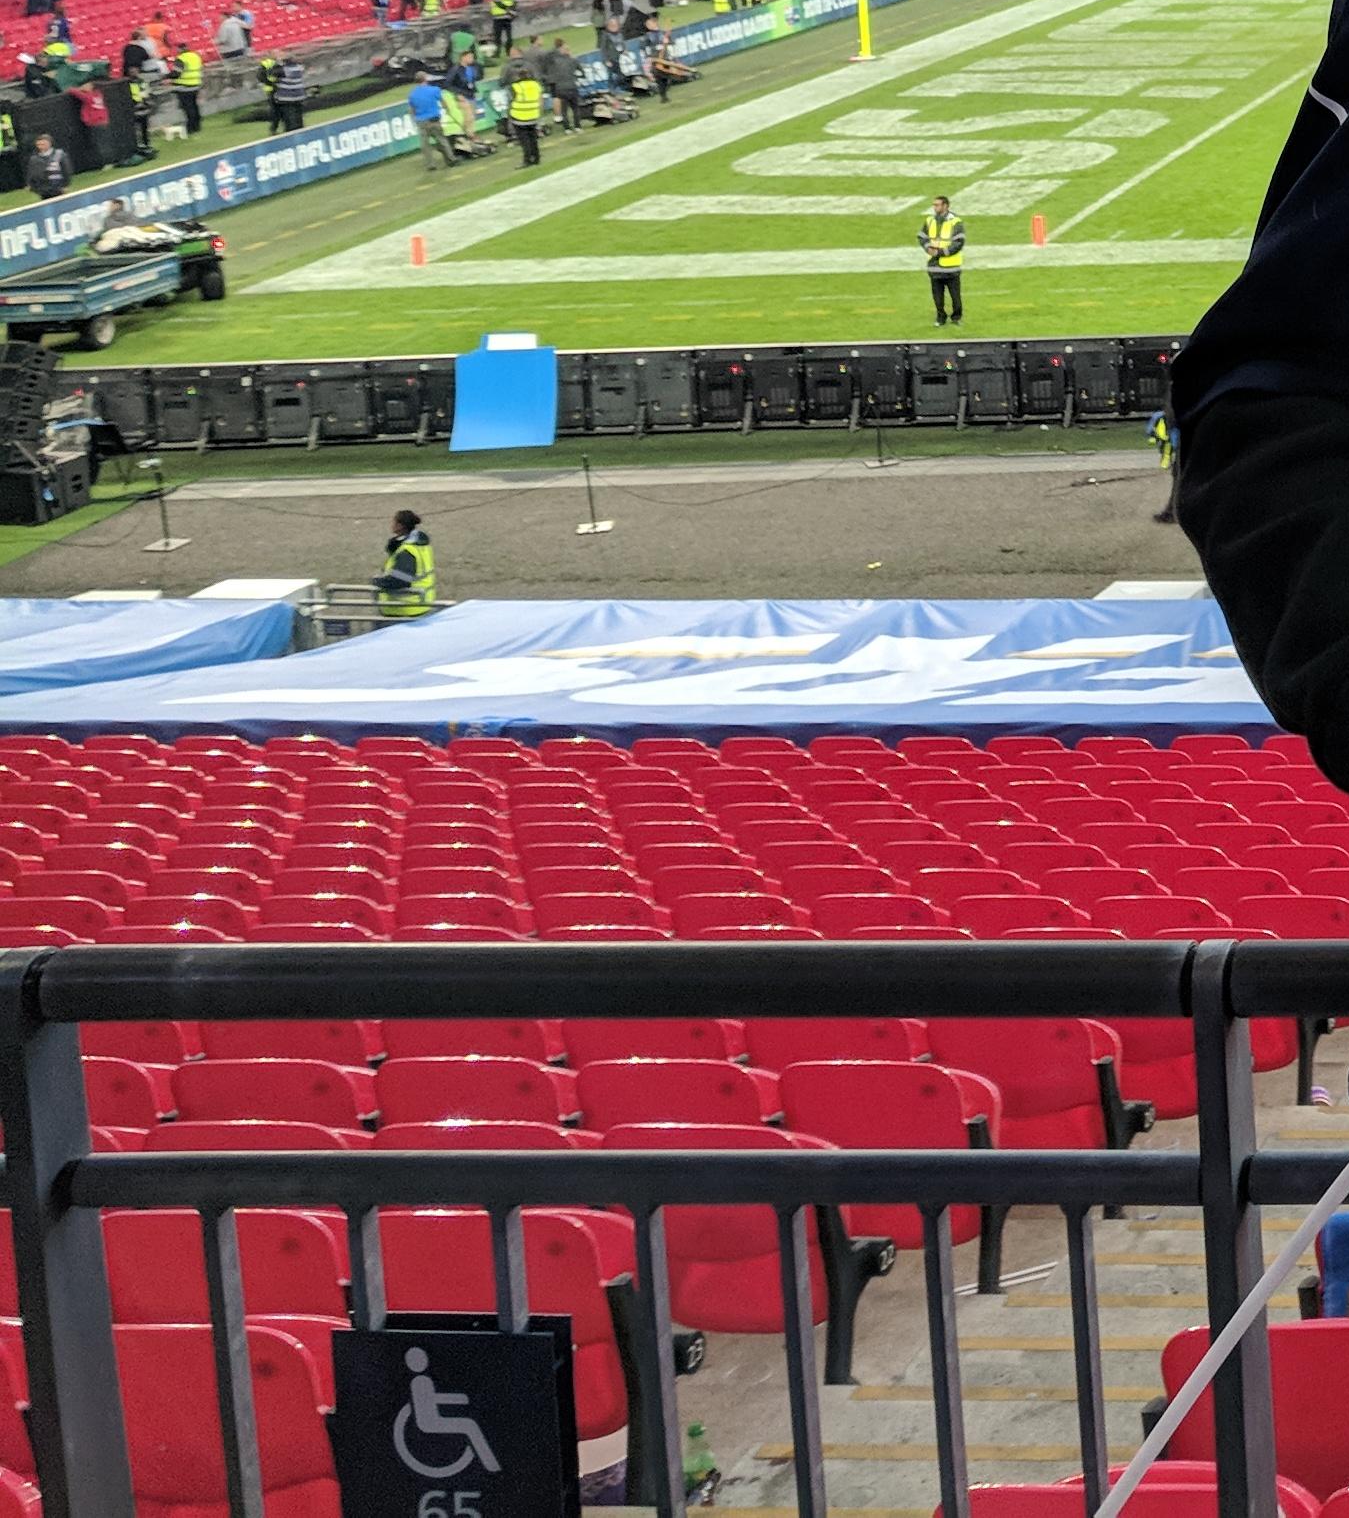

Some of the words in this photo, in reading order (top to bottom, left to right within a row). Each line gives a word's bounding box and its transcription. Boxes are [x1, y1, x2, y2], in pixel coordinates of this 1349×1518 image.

[254, 151, 296, 182] 2018
[294, 138, 330, 170] NFL
[329, 119, 393, 159] LONDON
[0, 221, 48, 260] NFL
[417, 1489, 483, 1518] 65
